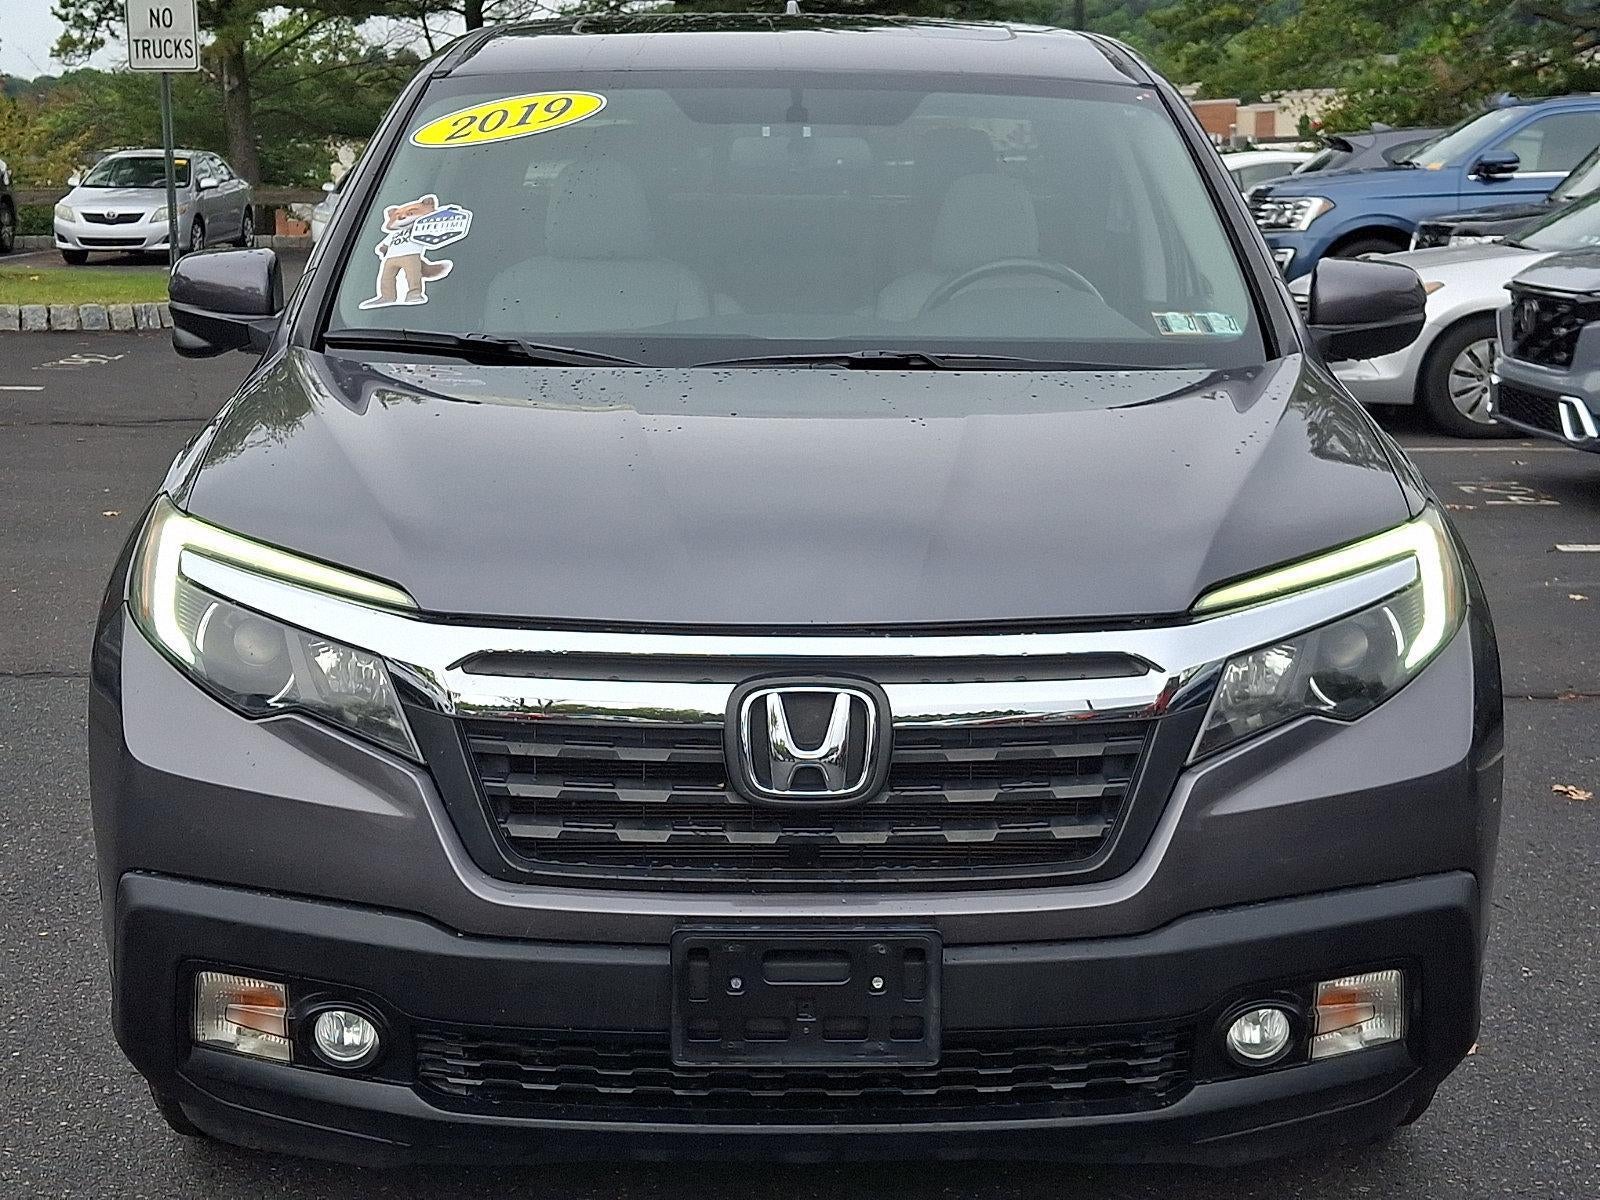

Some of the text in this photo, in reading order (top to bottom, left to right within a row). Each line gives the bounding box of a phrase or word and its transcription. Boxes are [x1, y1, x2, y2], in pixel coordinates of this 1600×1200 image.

[149, 7, 173, 28] NO
[133, 38, 194, 59] TRUCKS
[444, 97, 573, 141] 2019
